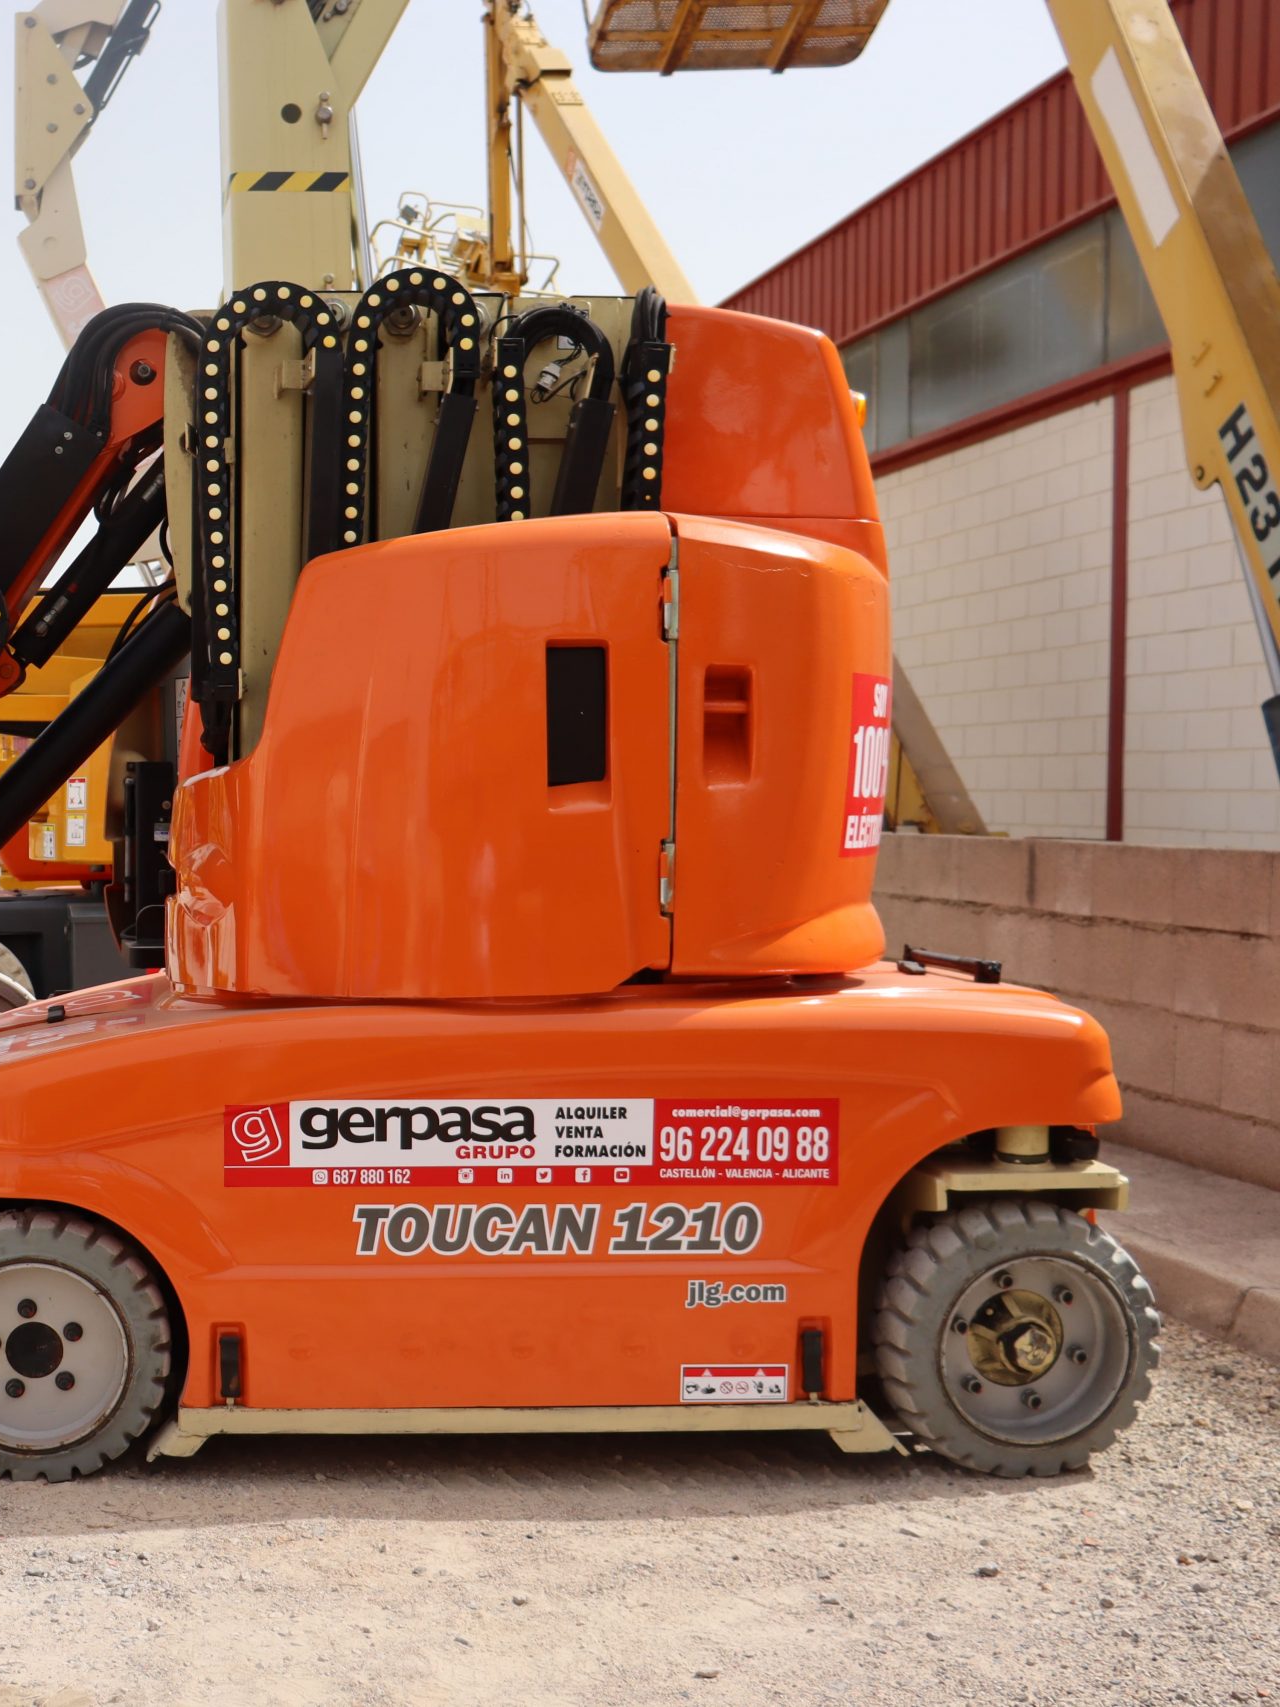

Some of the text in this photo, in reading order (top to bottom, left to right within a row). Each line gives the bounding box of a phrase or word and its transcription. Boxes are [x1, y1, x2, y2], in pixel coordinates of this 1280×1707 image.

[554, 1107, 627, 1120] ALQUILER
[672, 1105, 821, 1120] comercial@gerpasa.com
[299, 1104, 537, 1150] gerpasa
[554, 1126, 604, 1139] VENTA
[455, 1144, 536, 1159] GRUPO
[554, 1141, 647, 1158] FORMACIÓN
[660, 1126, 829, 1162] 96 224 09 88
[332, 1169, 410, 1184] 687 880 162
[659, 1166, 716, 1179] CASTELLÓN
[725, 1168, 773, 1179] VALENCIA
[782, 1168, 830, 1179] ALICANTE
[353, 1201, 762, 1256] TOUCAN 1210
[685, 1280, 786, 1308] jlg.com
